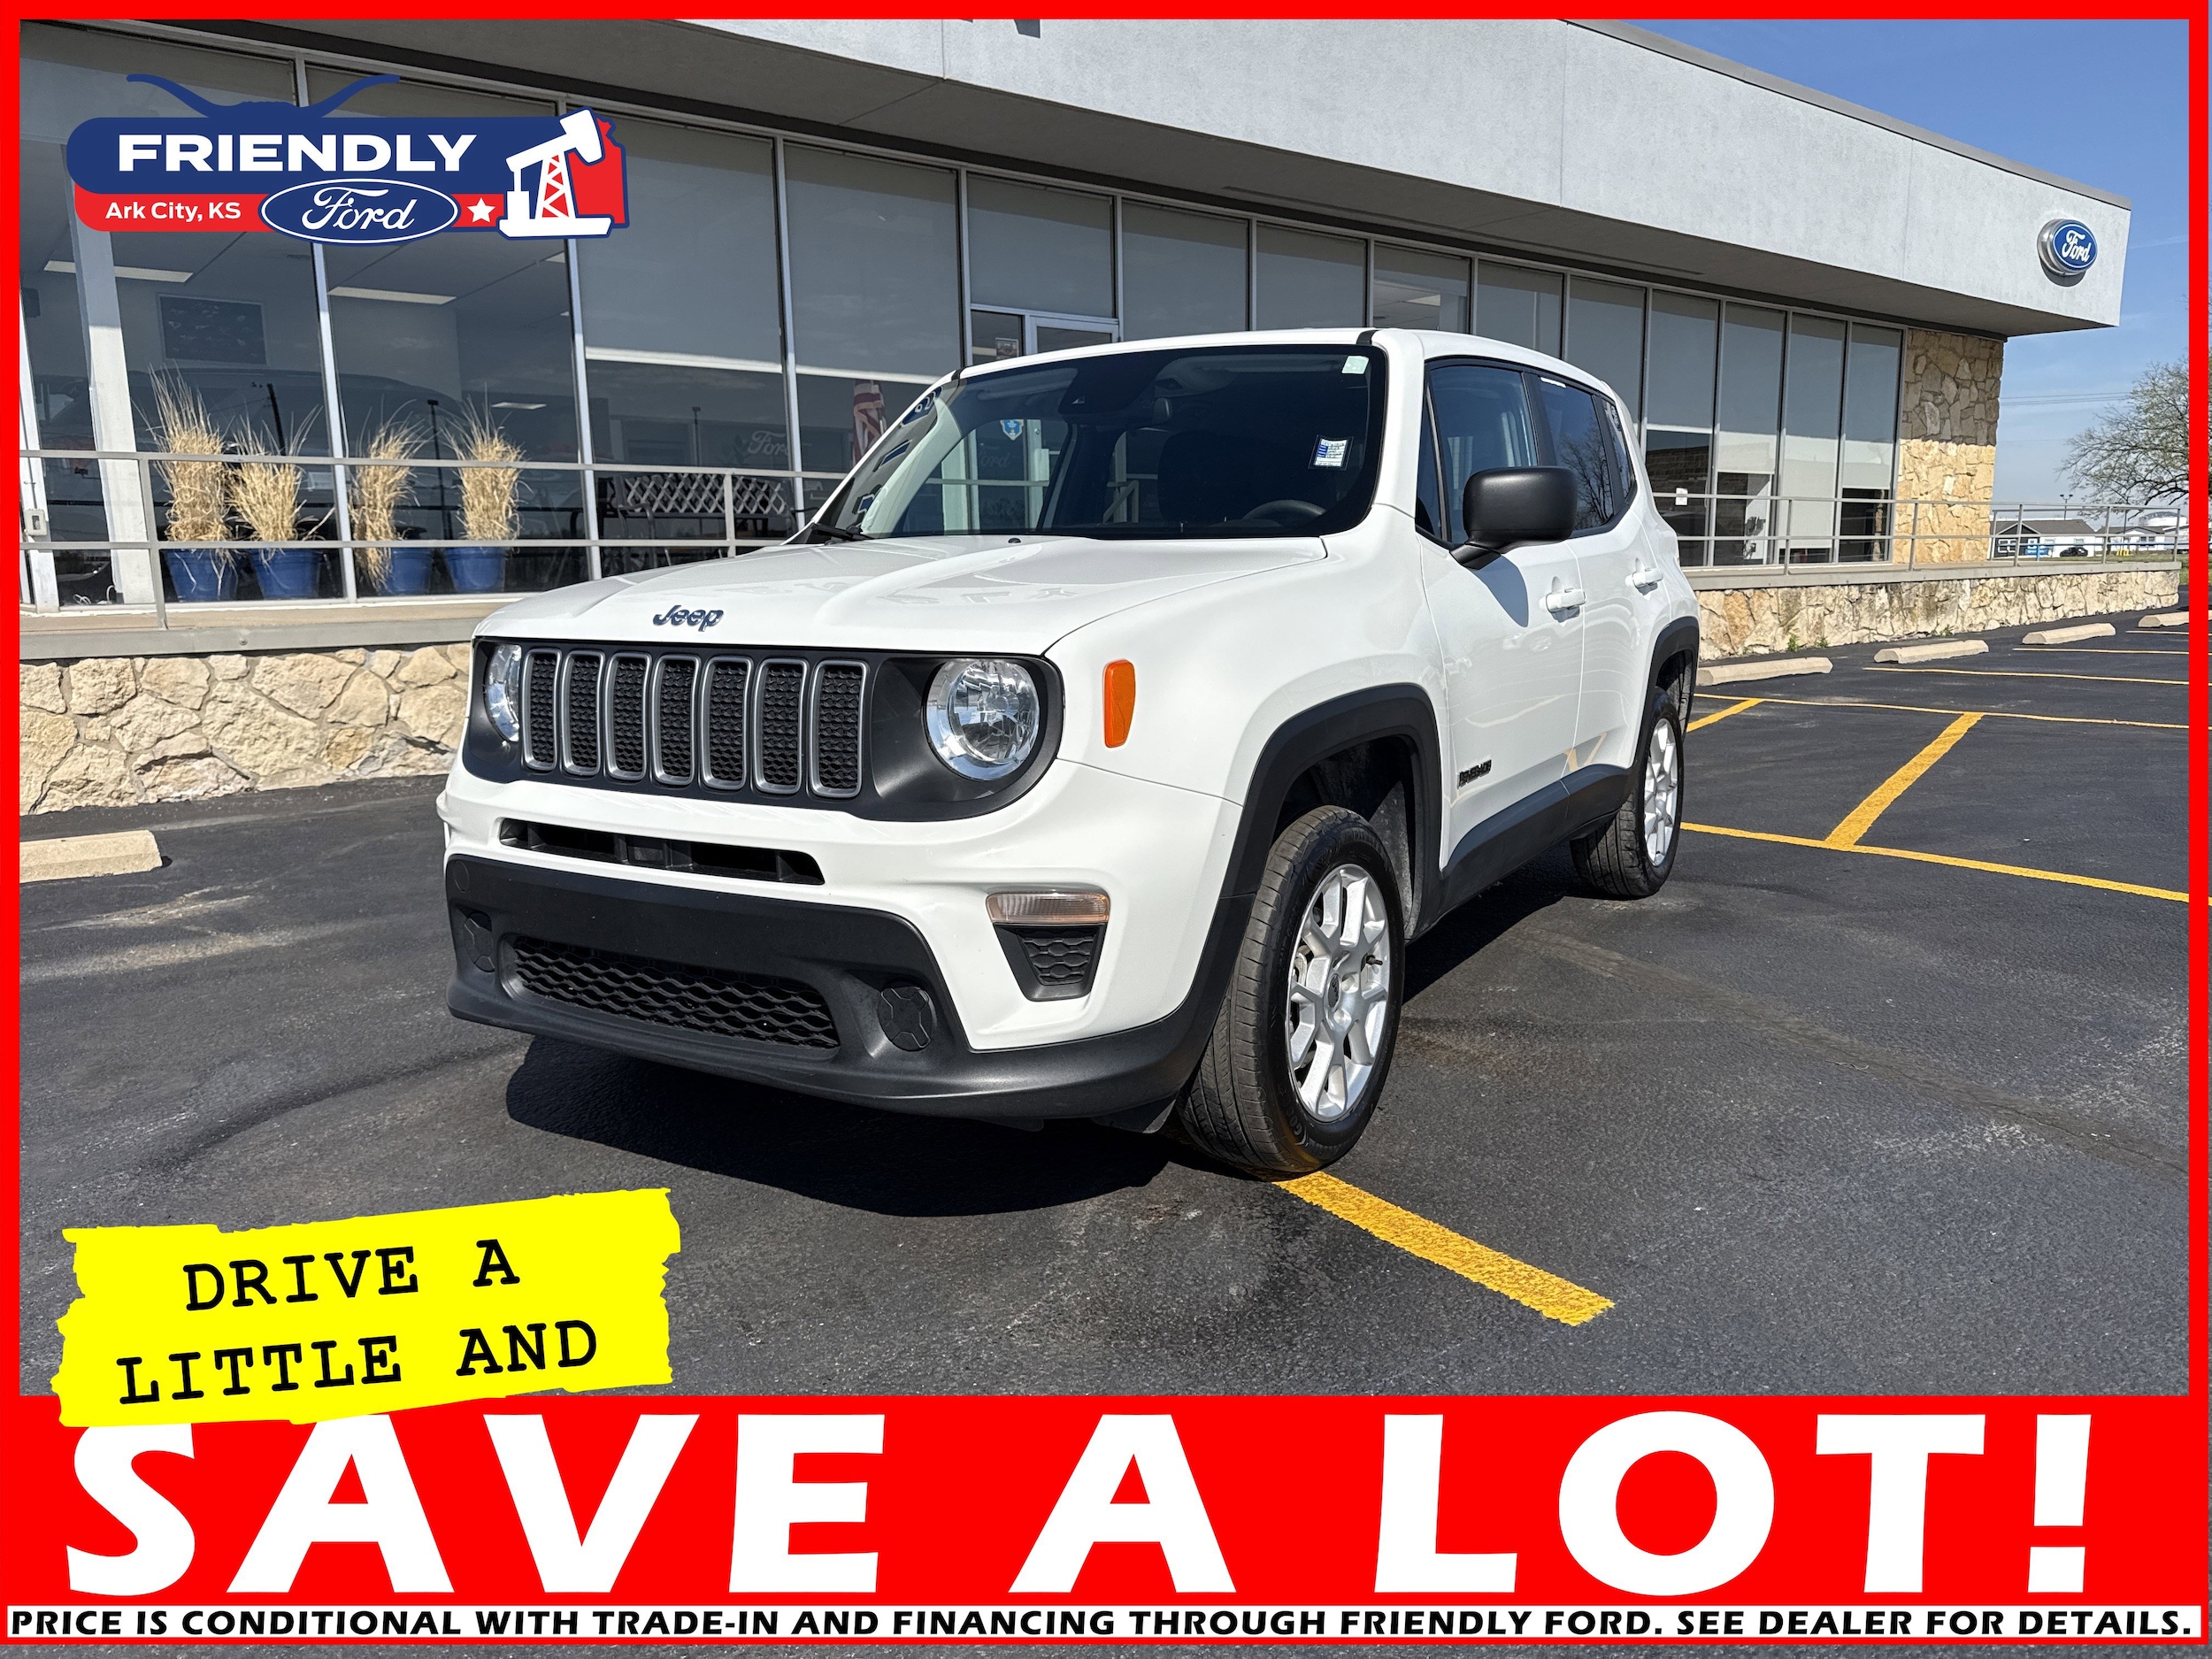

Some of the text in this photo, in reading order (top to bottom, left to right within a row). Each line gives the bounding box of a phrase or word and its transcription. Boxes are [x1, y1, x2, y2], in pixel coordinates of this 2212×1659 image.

[2062, 229, 2092, 263] Ford
[747, 430, 788, 456] For
[652, 604, 725, 633] Jeep
